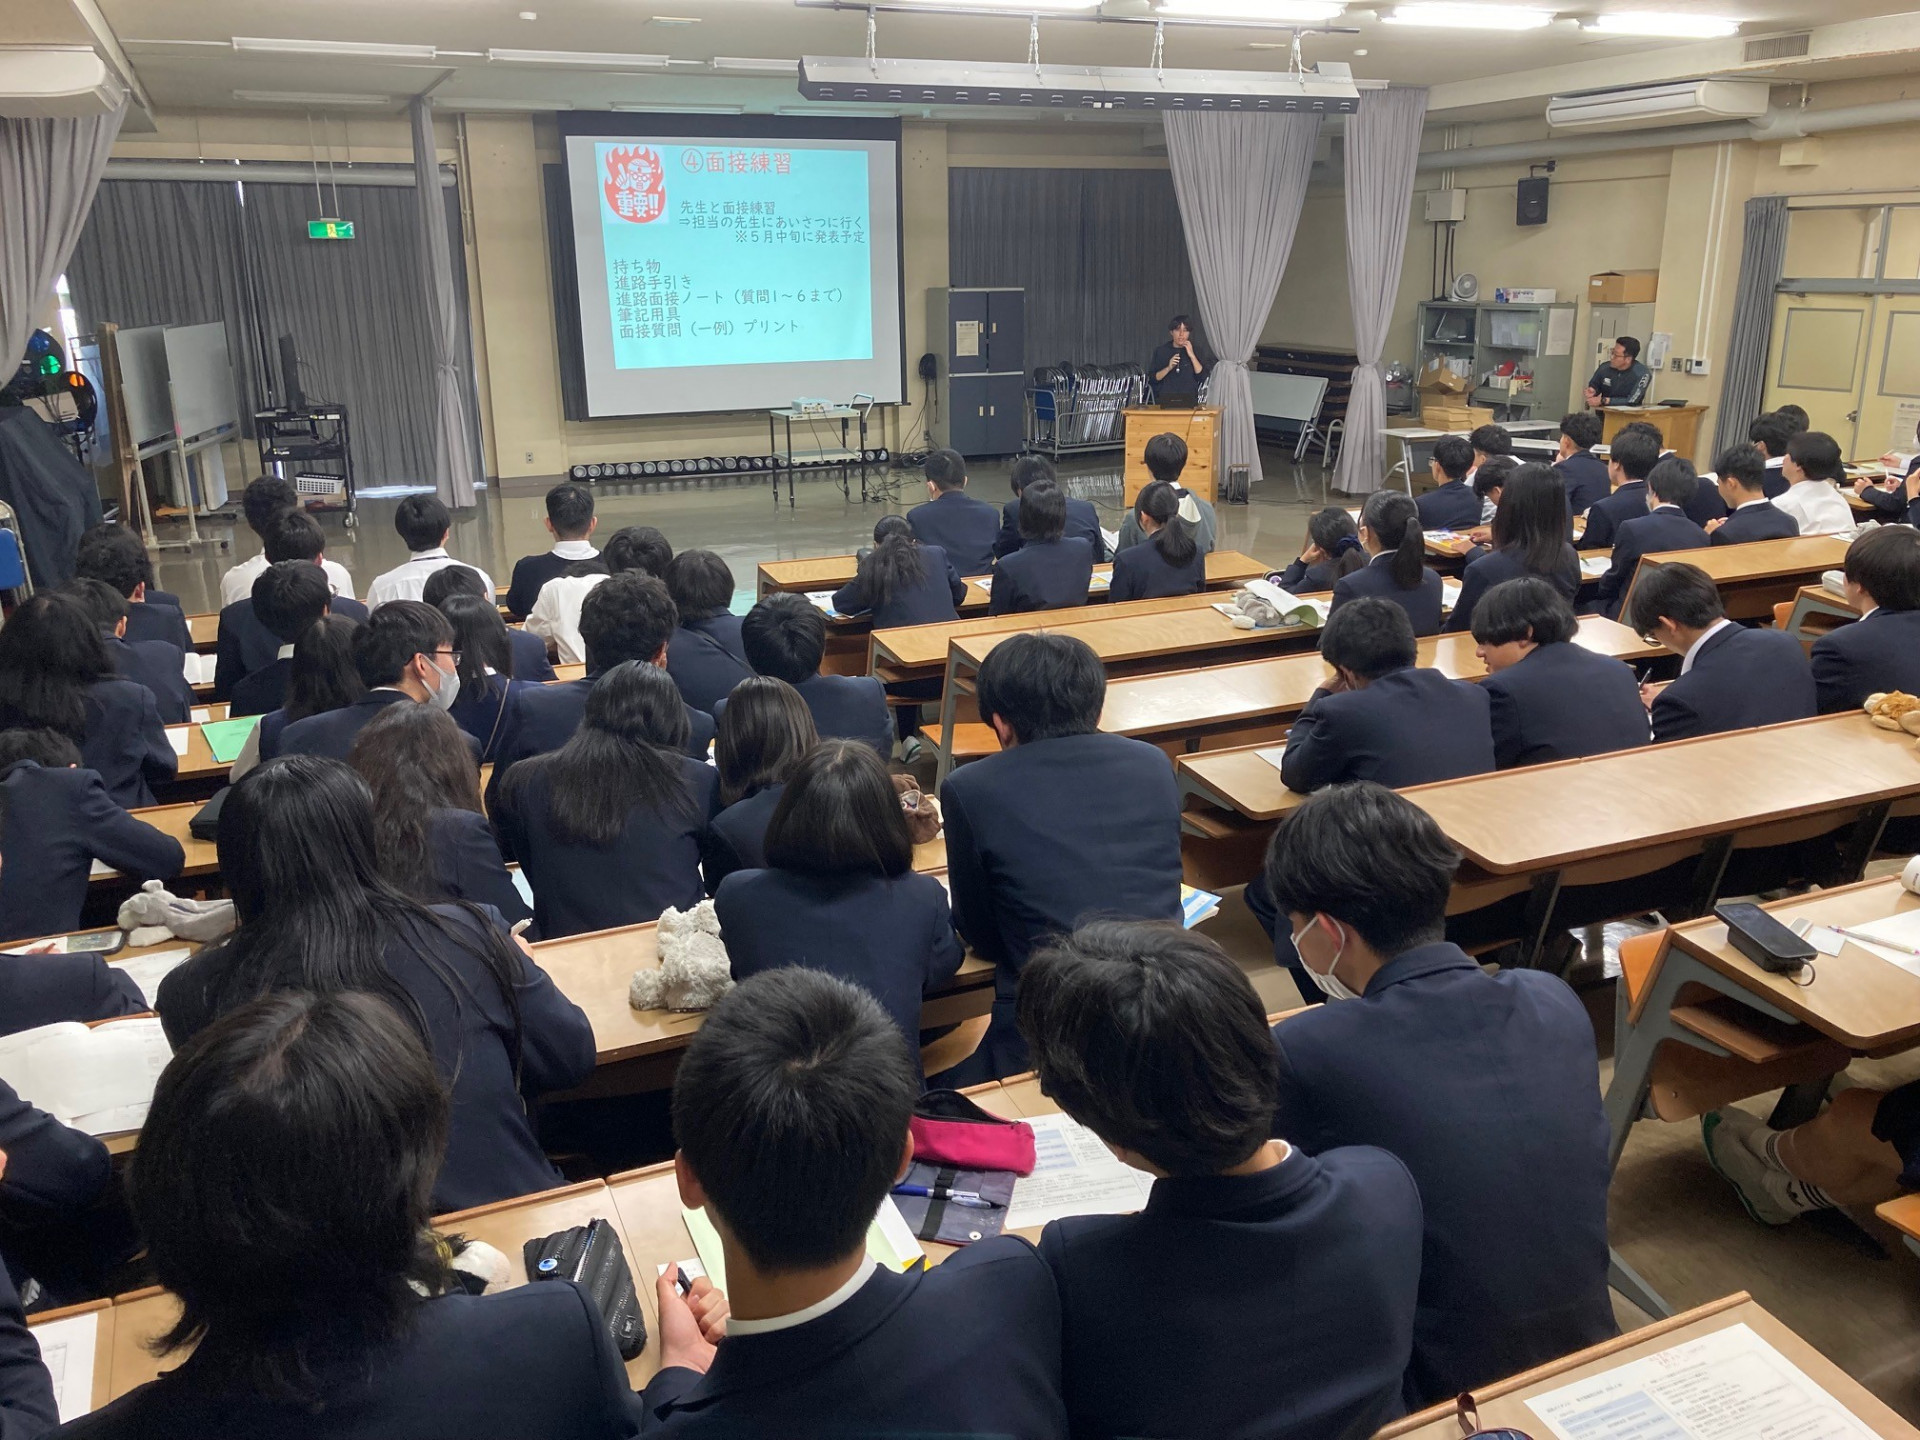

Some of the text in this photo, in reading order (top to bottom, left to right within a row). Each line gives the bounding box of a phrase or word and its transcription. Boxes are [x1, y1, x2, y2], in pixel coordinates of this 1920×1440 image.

[680, 200, 776, 215] 先生と面接練習
[612, 258, 661, 274] 持ち物
[614, 274, 692, 290] 進路手引き
[617, 307, 681, 323] 筆記用具
